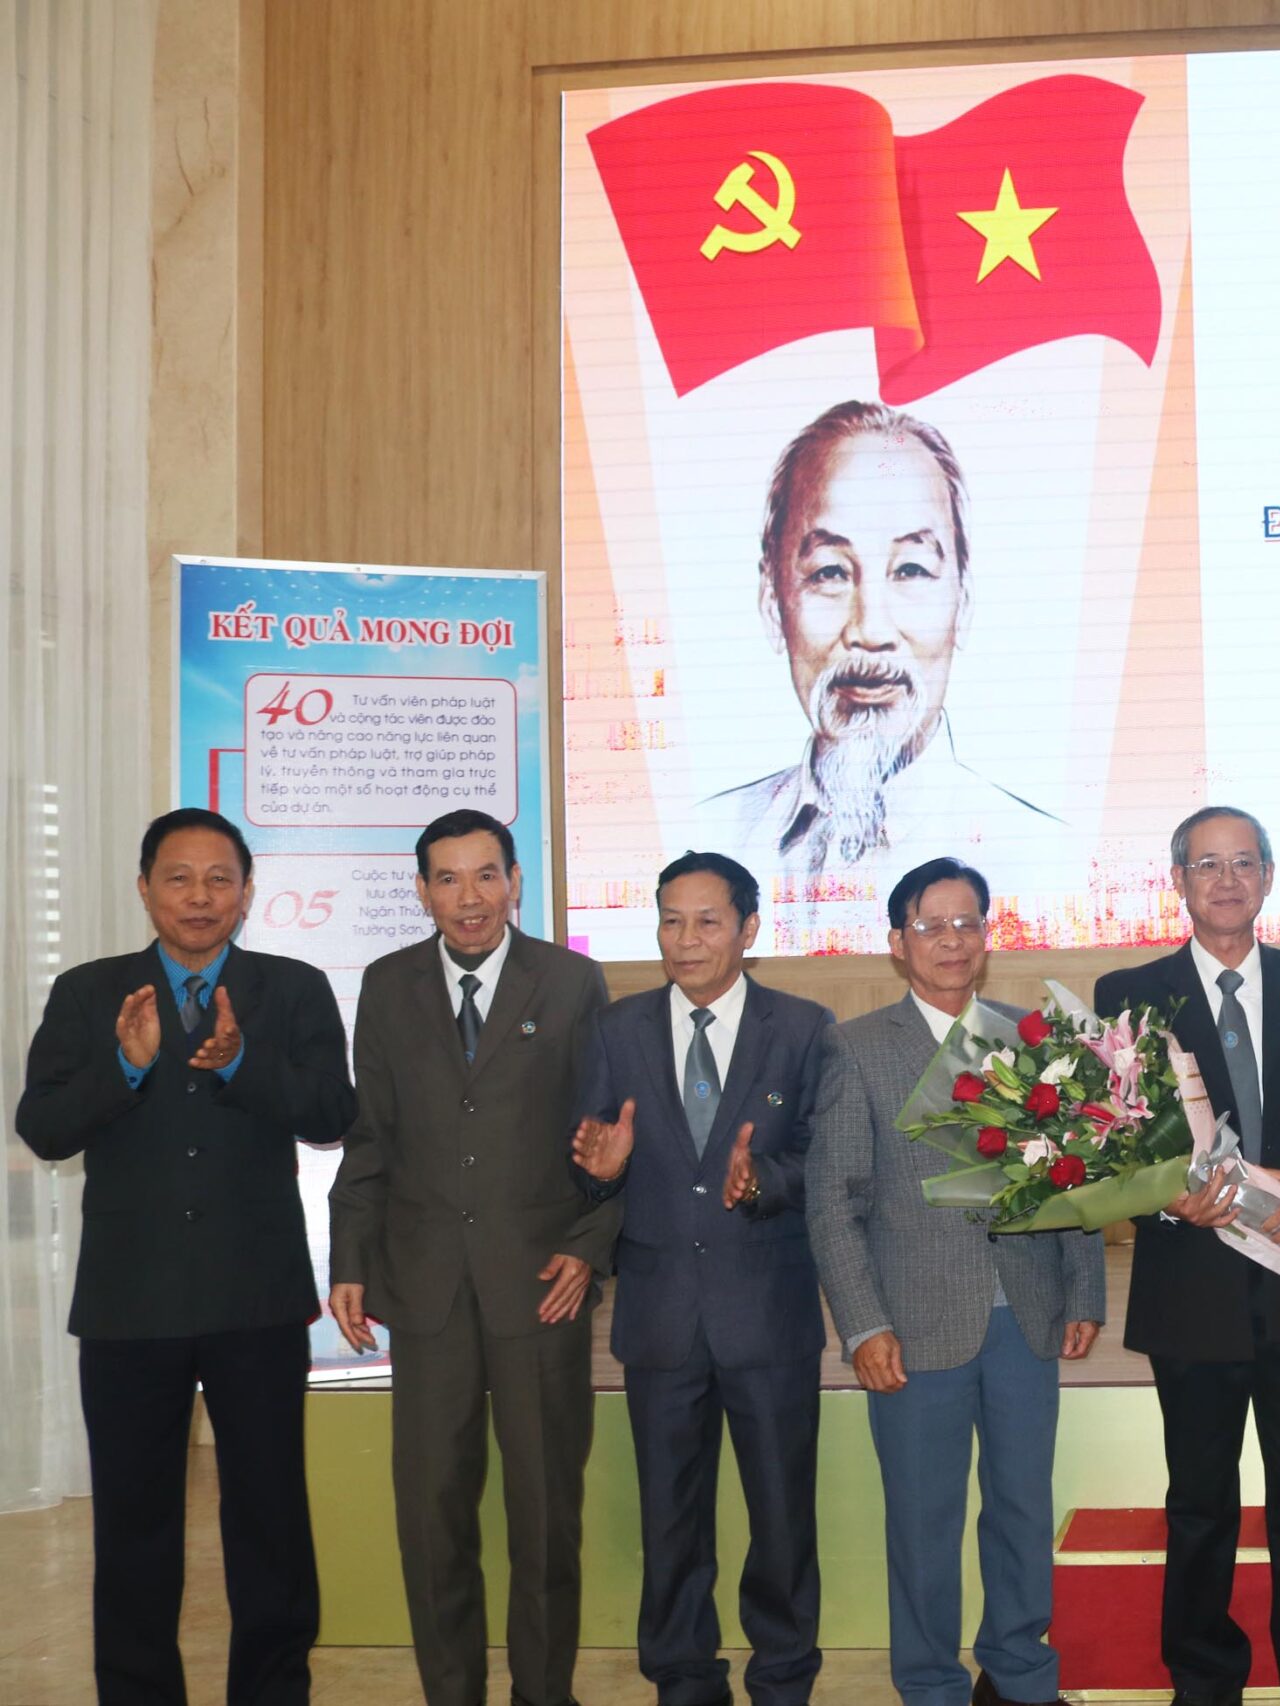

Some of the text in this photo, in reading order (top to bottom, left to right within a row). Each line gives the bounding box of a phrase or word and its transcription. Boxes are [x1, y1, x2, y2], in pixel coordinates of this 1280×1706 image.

[211, 601, 513, 652] KẾT QUẢ MONG ĐỢI
[256, 681, 334, 726] 40
[352, 693, 496, 710] Tư vấn viên pháp luật
[329, 713, 496, 727] và cộng tác viên được đào
[260, 729, 497, 745] tạo và nâng cao lực liên quan
[260, 745, 496, 763] về tư vấn pháp trợ giúp pháp
[282, 764, 466, 781] truyền thông và tham gia
[260, 782, 497, 798] tiếp vào một số hoạt động cụ thể
[263, 889, 341, 930] 05
